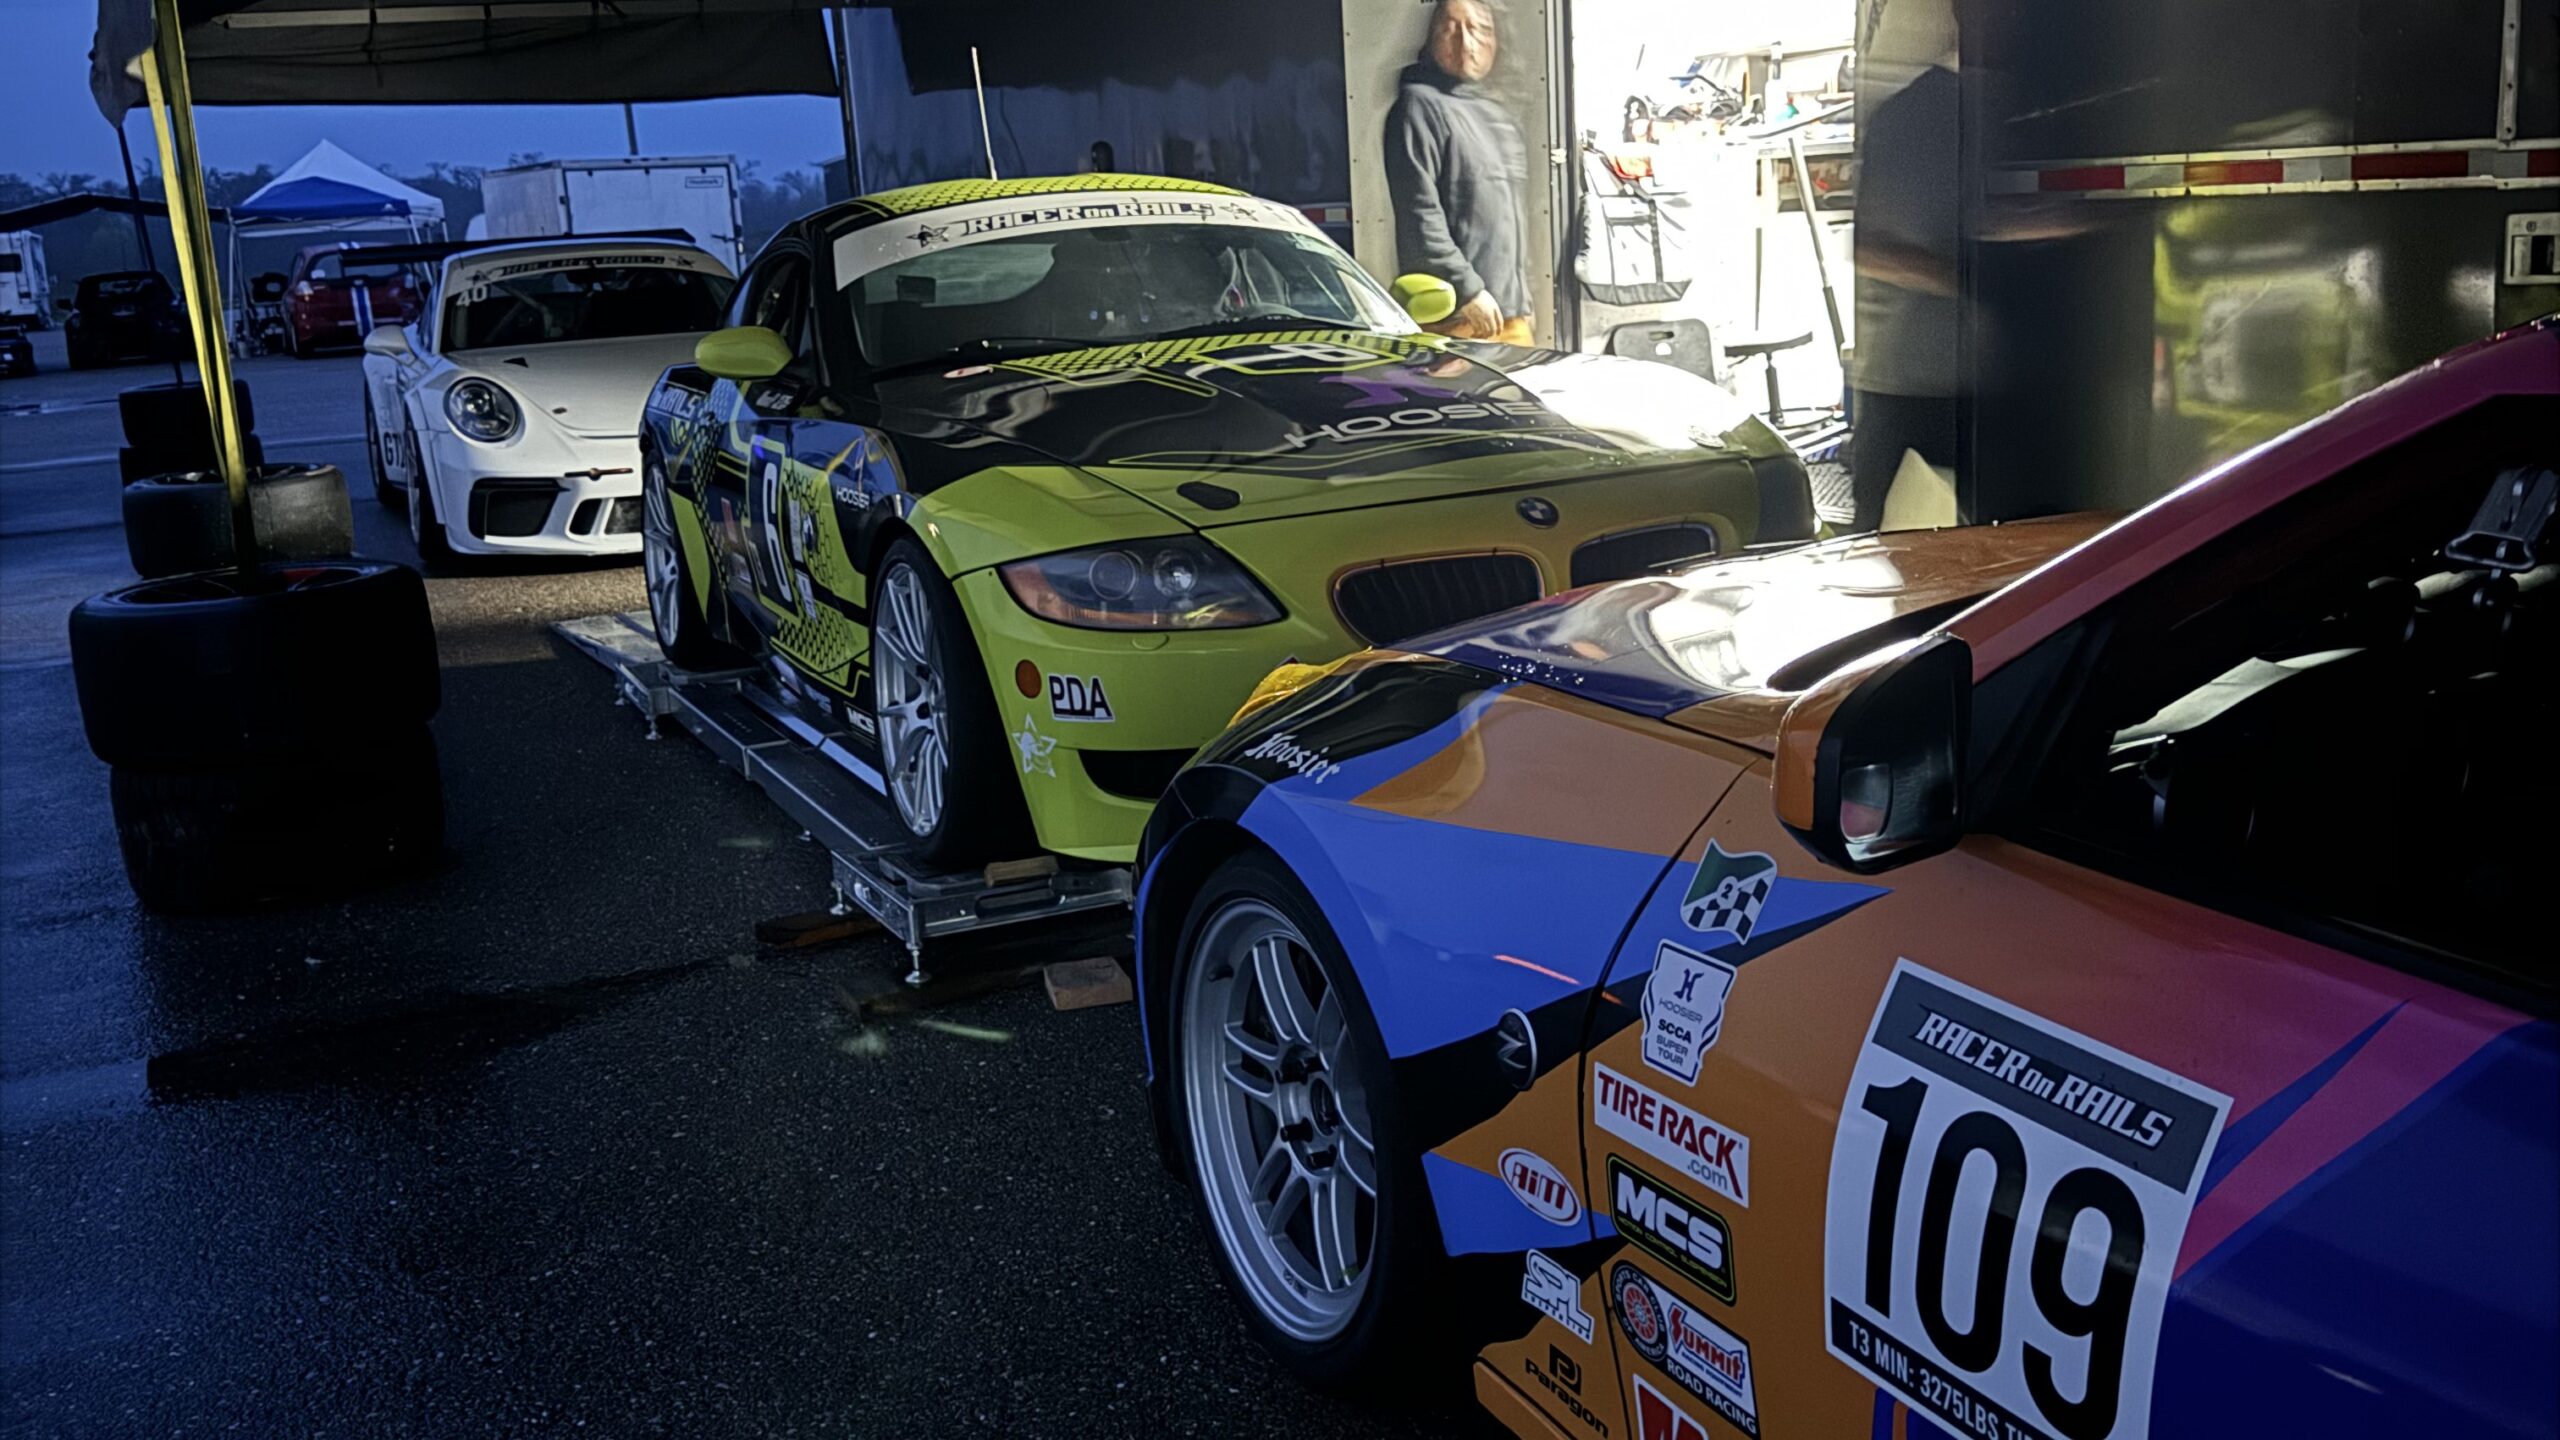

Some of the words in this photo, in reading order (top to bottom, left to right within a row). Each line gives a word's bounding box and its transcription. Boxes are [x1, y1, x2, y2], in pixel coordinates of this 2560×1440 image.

[964, 206, 1082, 236] RACER
[1084, 206, 1115, 219] on
[1118, 202, 1214, 217] RAILS
[456, 285, 488, 307] 40
[1284, 401, 1556, 448] HOOSIE
[836, 487, 870, 509] HOOSIER
[762, 462, 793, 603] 6
[1048, 675, 1113, 718] PDA
[1243, 732, 1341, 785] Hoosier
[1720, 883, 1733, 900] 2
[1657, 1018, 1693, 1044] SCCA
[1659, 998, 1703, 1023] HOOSIER
[1656, 1034, 1689, 1057] SUPER
[1657, 1046, 1684, 1067] TOUR
[1915, 1012, 2030, 1085] RACER
[2018, 1066, 2056, 1100] on
[2050, 1073, 2174, 1150] RAILS
[1598, 1071, 1657, 1132] TIRE
[1658, 1103, 1743, 1200] RACK
[1687, 1159, 1728, 1191] .com
[1617, 1171, 1724, 1270] MCS
[1862, 1077, 2146, 1440] 109
[1525, 1251, 1593, 1332] SPL
[1669, 1303, 1744, 1386] SUMMIT
[1525, 1357, 1609, 1440] Paragon
[1666, 1358, 1704, 1394] ROAD
[1705, 1388, 1757, 1435] RACING
[1849, 1320, 1870, 1357] T3
[1875, 1337, 1915, 1388] MIN:
[1919, 1368, 1999, 1440] 3275LBS
